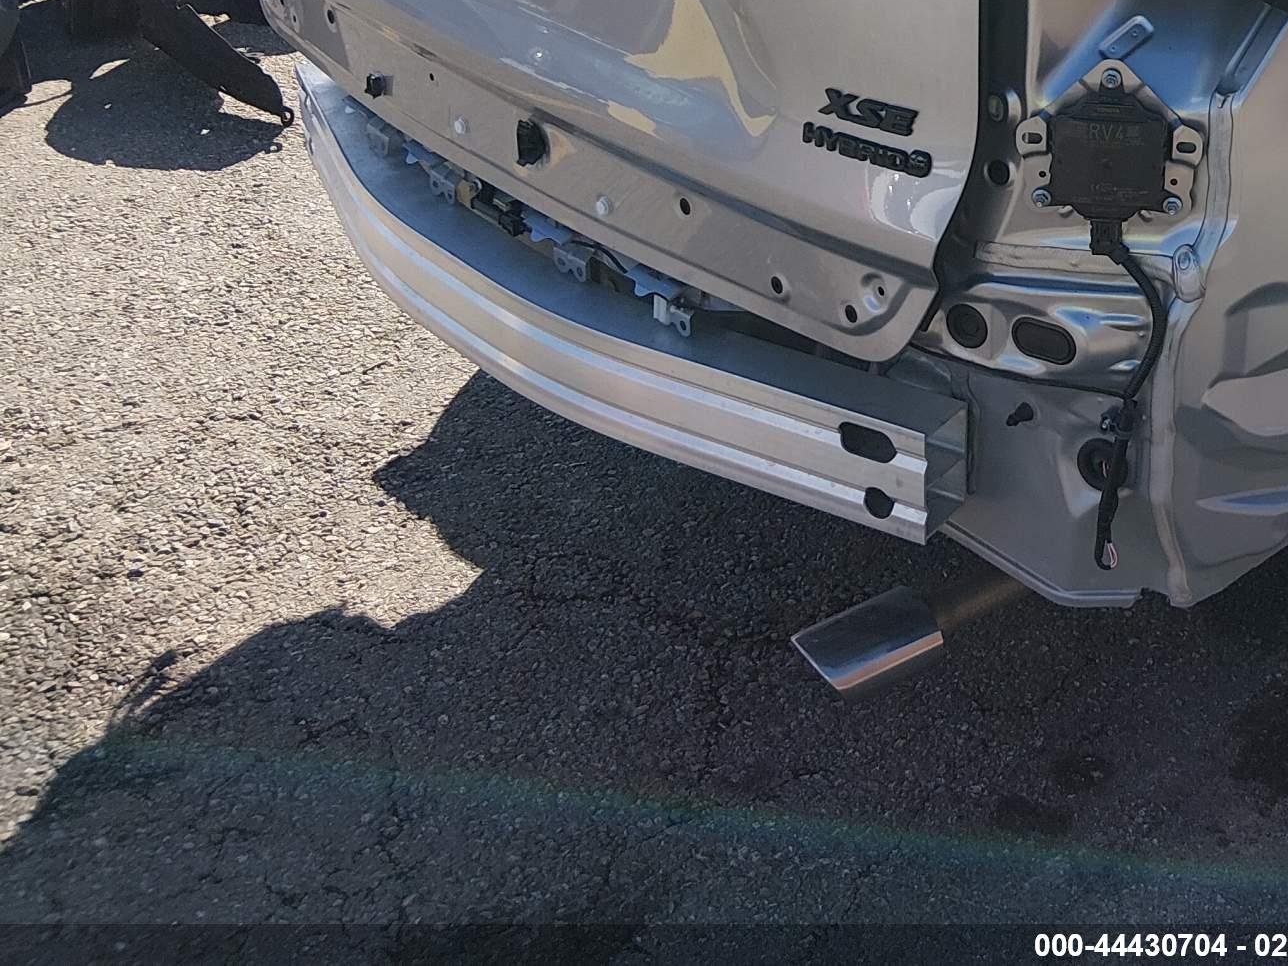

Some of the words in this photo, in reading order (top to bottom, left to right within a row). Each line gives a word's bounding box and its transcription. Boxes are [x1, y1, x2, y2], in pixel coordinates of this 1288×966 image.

[818, 87, 920, 137] XSE
[1088, 122, 1125, 139] RV4
[802, 121, 910, 173] HYBRID
